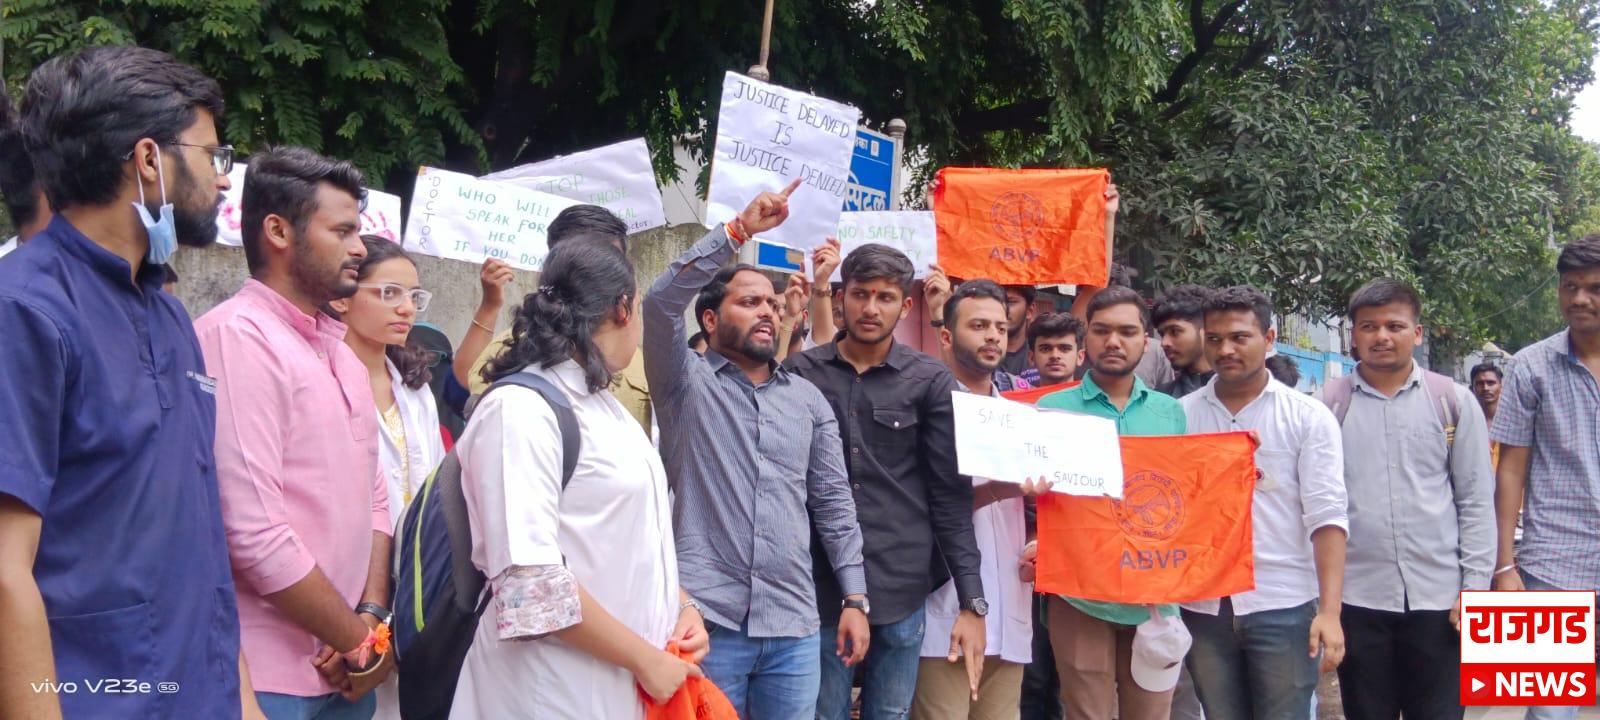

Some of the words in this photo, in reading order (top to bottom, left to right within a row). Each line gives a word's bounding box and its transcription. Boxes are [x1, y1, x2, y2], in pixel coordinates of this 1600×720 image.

[734, 80, 789, 114] JUSTICE
[798, 103, 850, 138] DELAYED
[769, 120, 794, 146] IS
[728, 140, 792, 176] JUSTICE
[800, 163, 847, 198] DENIED
[418, 176, 441, 250] DOCTOR
[458, 186, 497, 205] WHO
[516, 199, 550, 218] WILL
[465, 208, 510, 226] SPEAK
[517, 219, 546, 237] FOR
[838, 226, 857, 241] NO
[488, 231, 516, 246] HER
[454, 240, 470, 252] IF
[483, 245, 509, 260] YOU
[520, 253, 545, 268] DON
[988, 246, 1041, 263] ABVP
[976, 407, 1015, 430] SAVE
[1023, 441, 1049, 459] THE
[1053, 470, 1106, 490] SAVIOUR
[1119, 548, 1188, 571] ABVP
